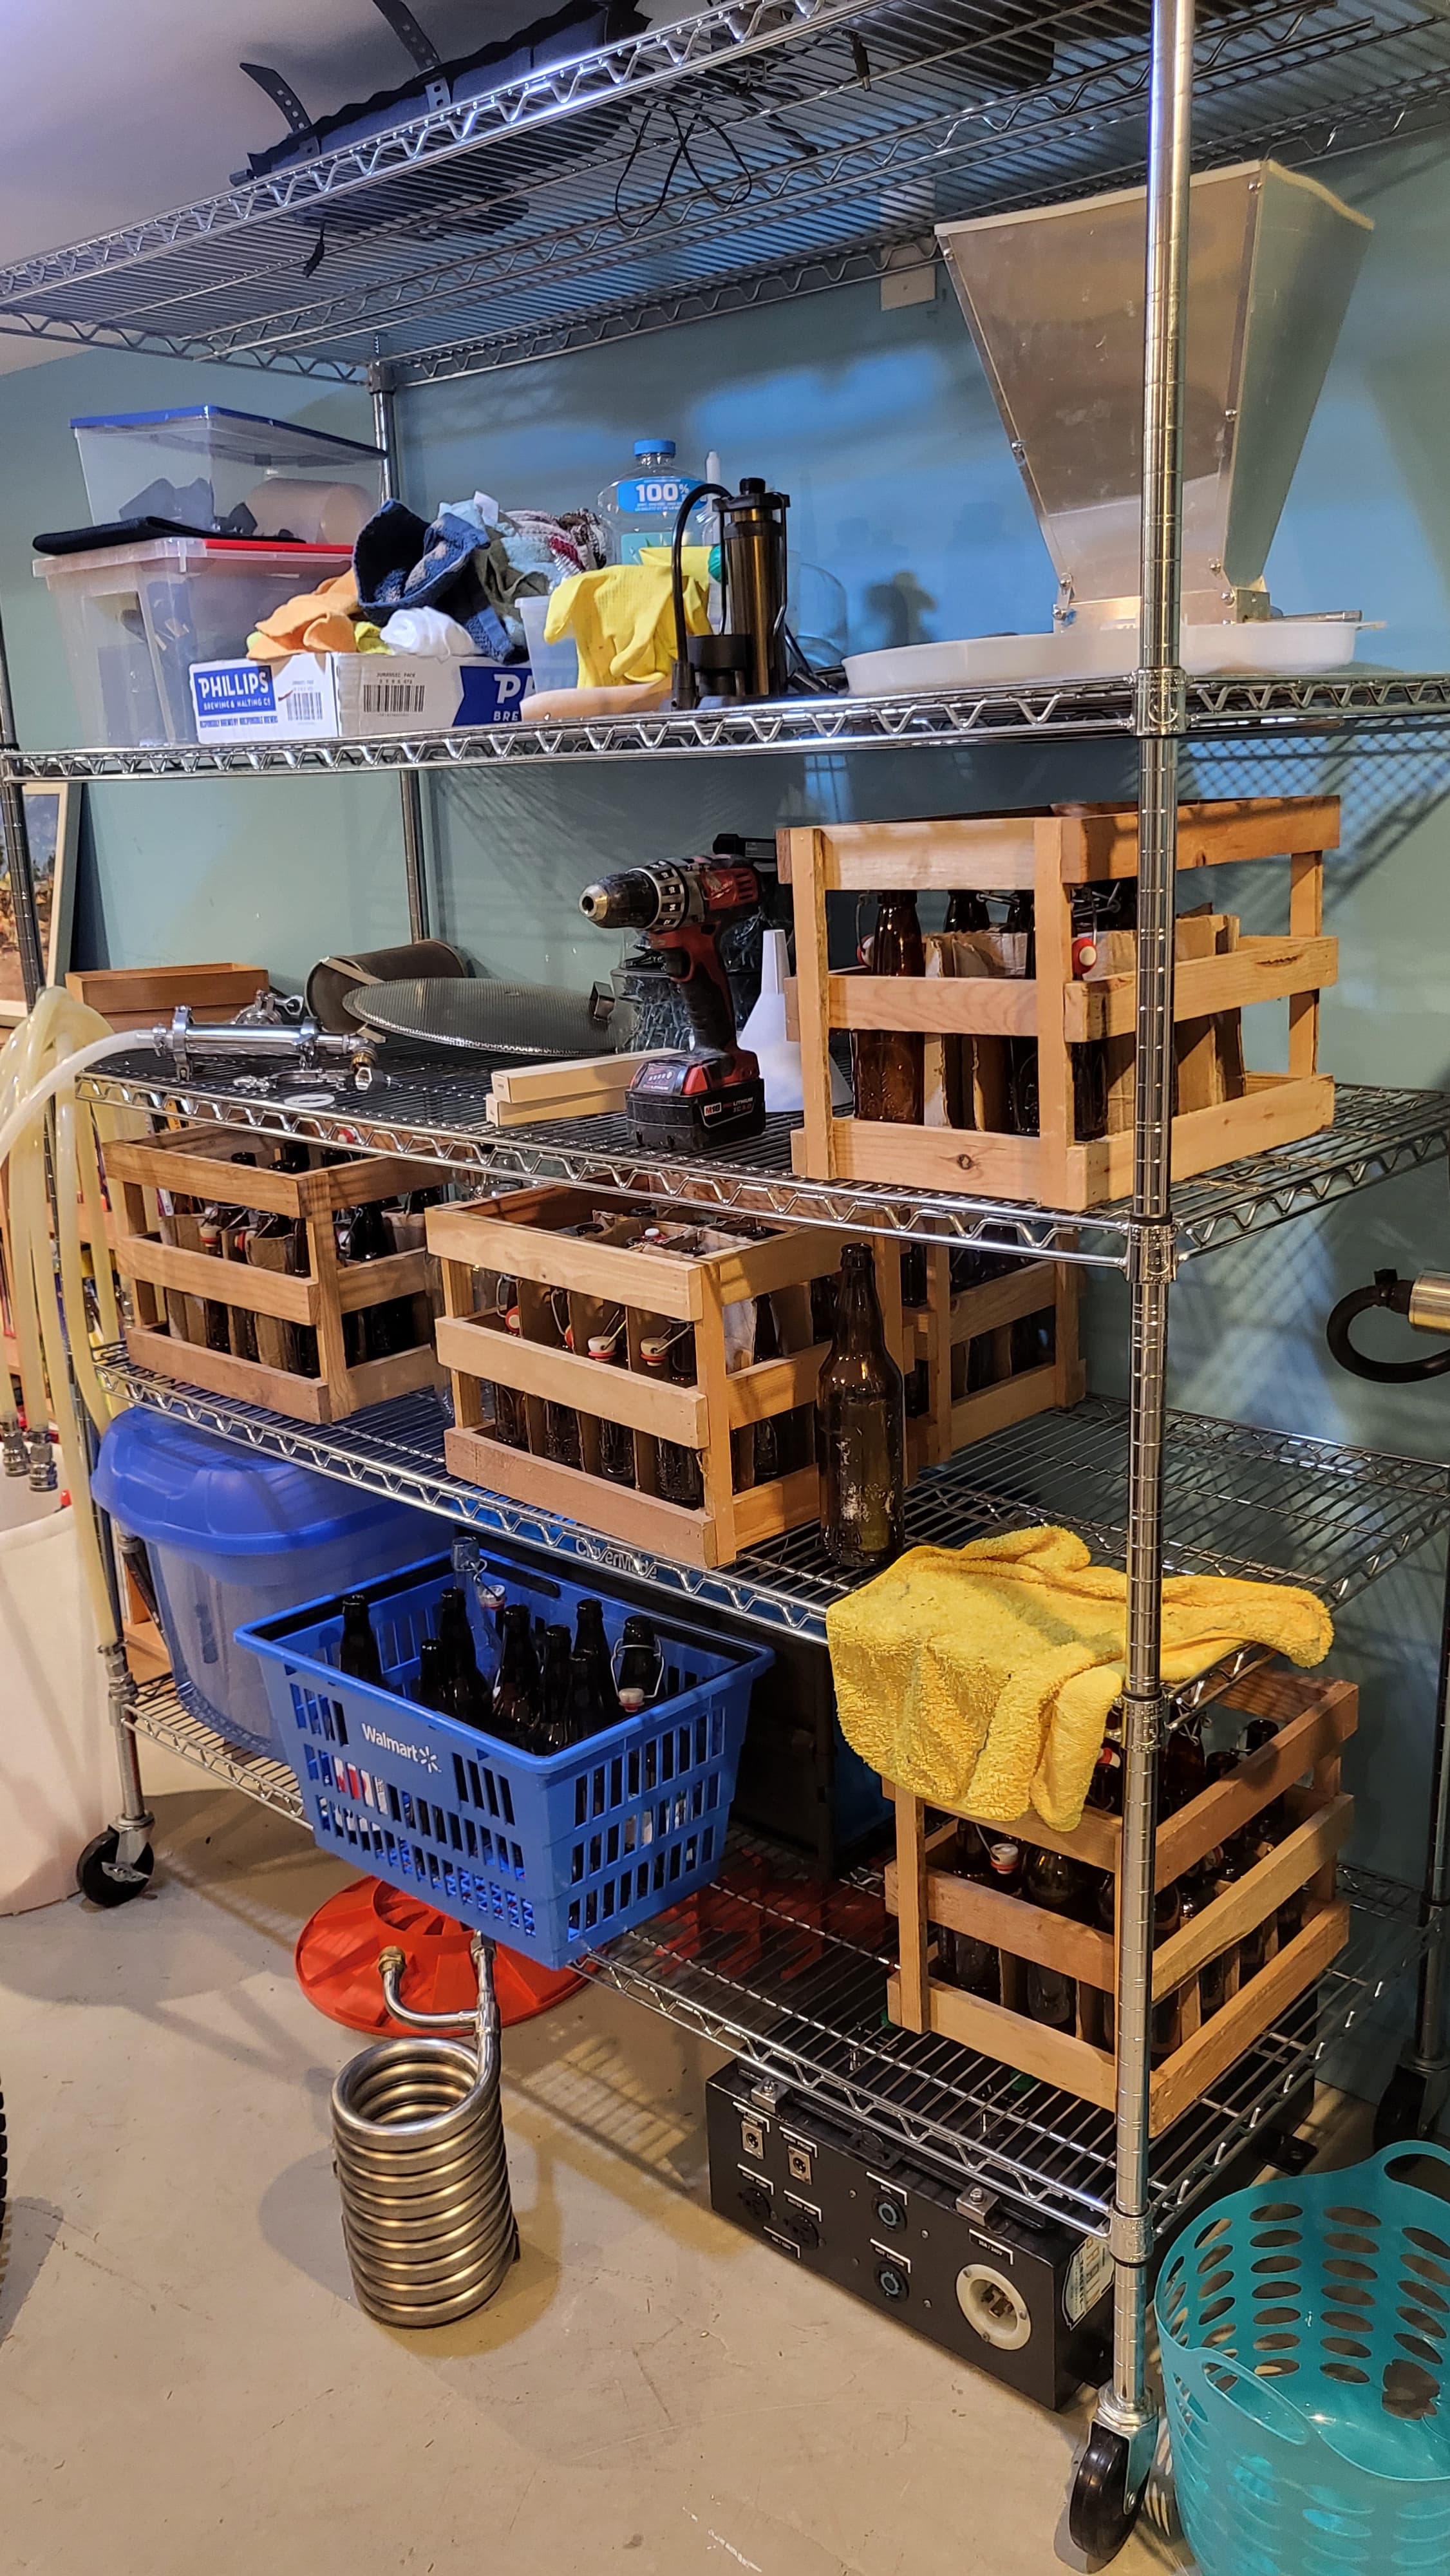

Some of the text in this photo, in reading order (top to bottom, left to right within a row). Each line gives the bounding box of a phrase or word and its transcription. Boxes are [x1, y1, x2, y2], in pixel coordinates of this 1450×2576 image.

[636, 483, 689, 502] 100%
[198, 672, 269, 699] PHILLIPS
[203, 700, 229, 710] BREWING
[237, 698, 262, 708] MALTING
[361, 1723, 419, 1762] Walmart
